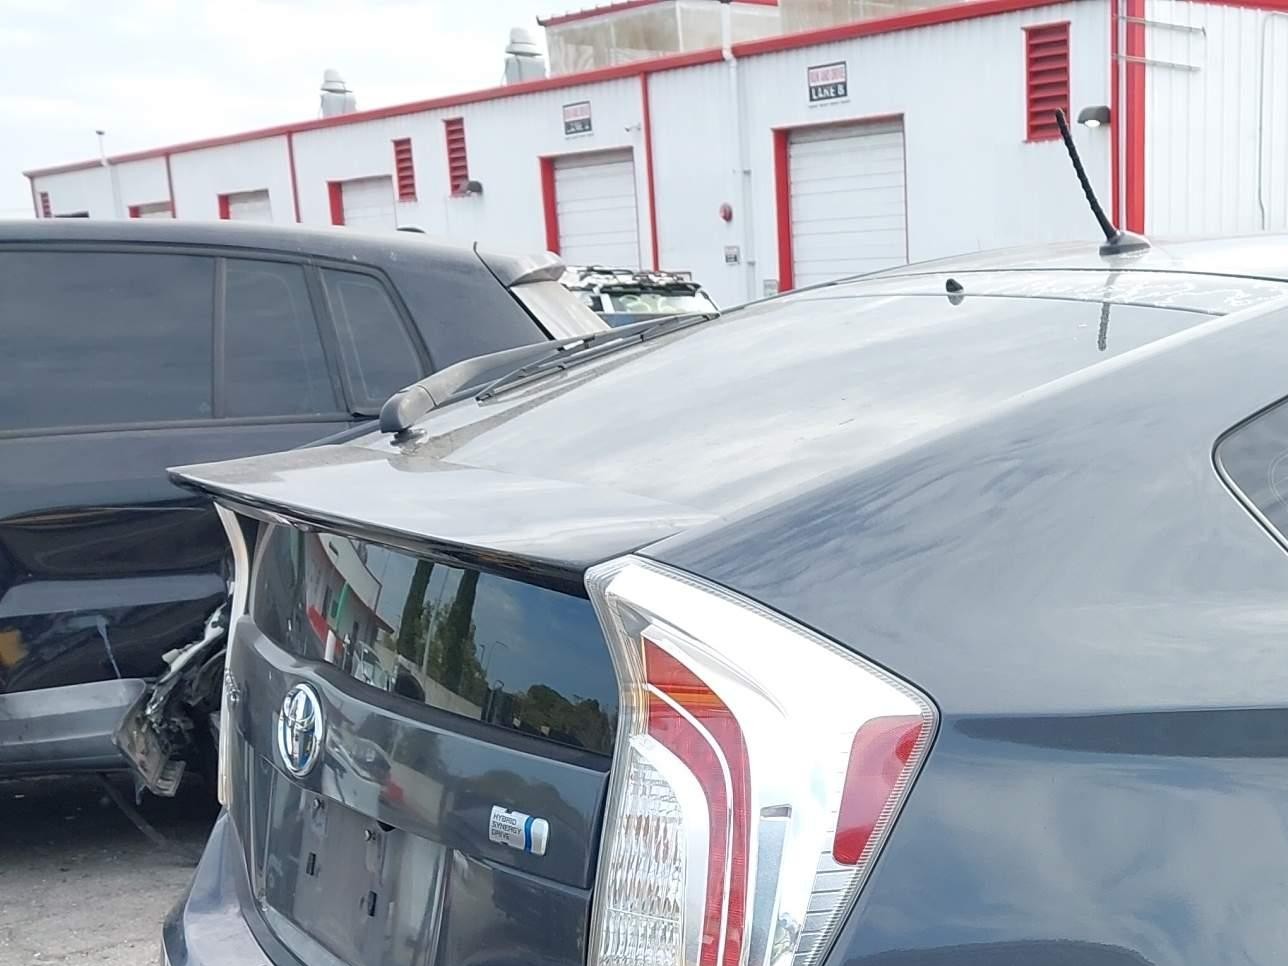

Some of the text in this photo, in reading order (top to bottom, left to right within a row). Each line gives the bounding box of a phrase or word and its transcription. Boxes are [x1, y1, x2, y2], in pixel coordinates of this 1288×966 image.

[811, 85, 836, 100] LANE
[493, 814, 517, 825] HYBRID
[491, 820, 522, 835] SYNERGY
[491, 829, 510, 840] DRIVE
